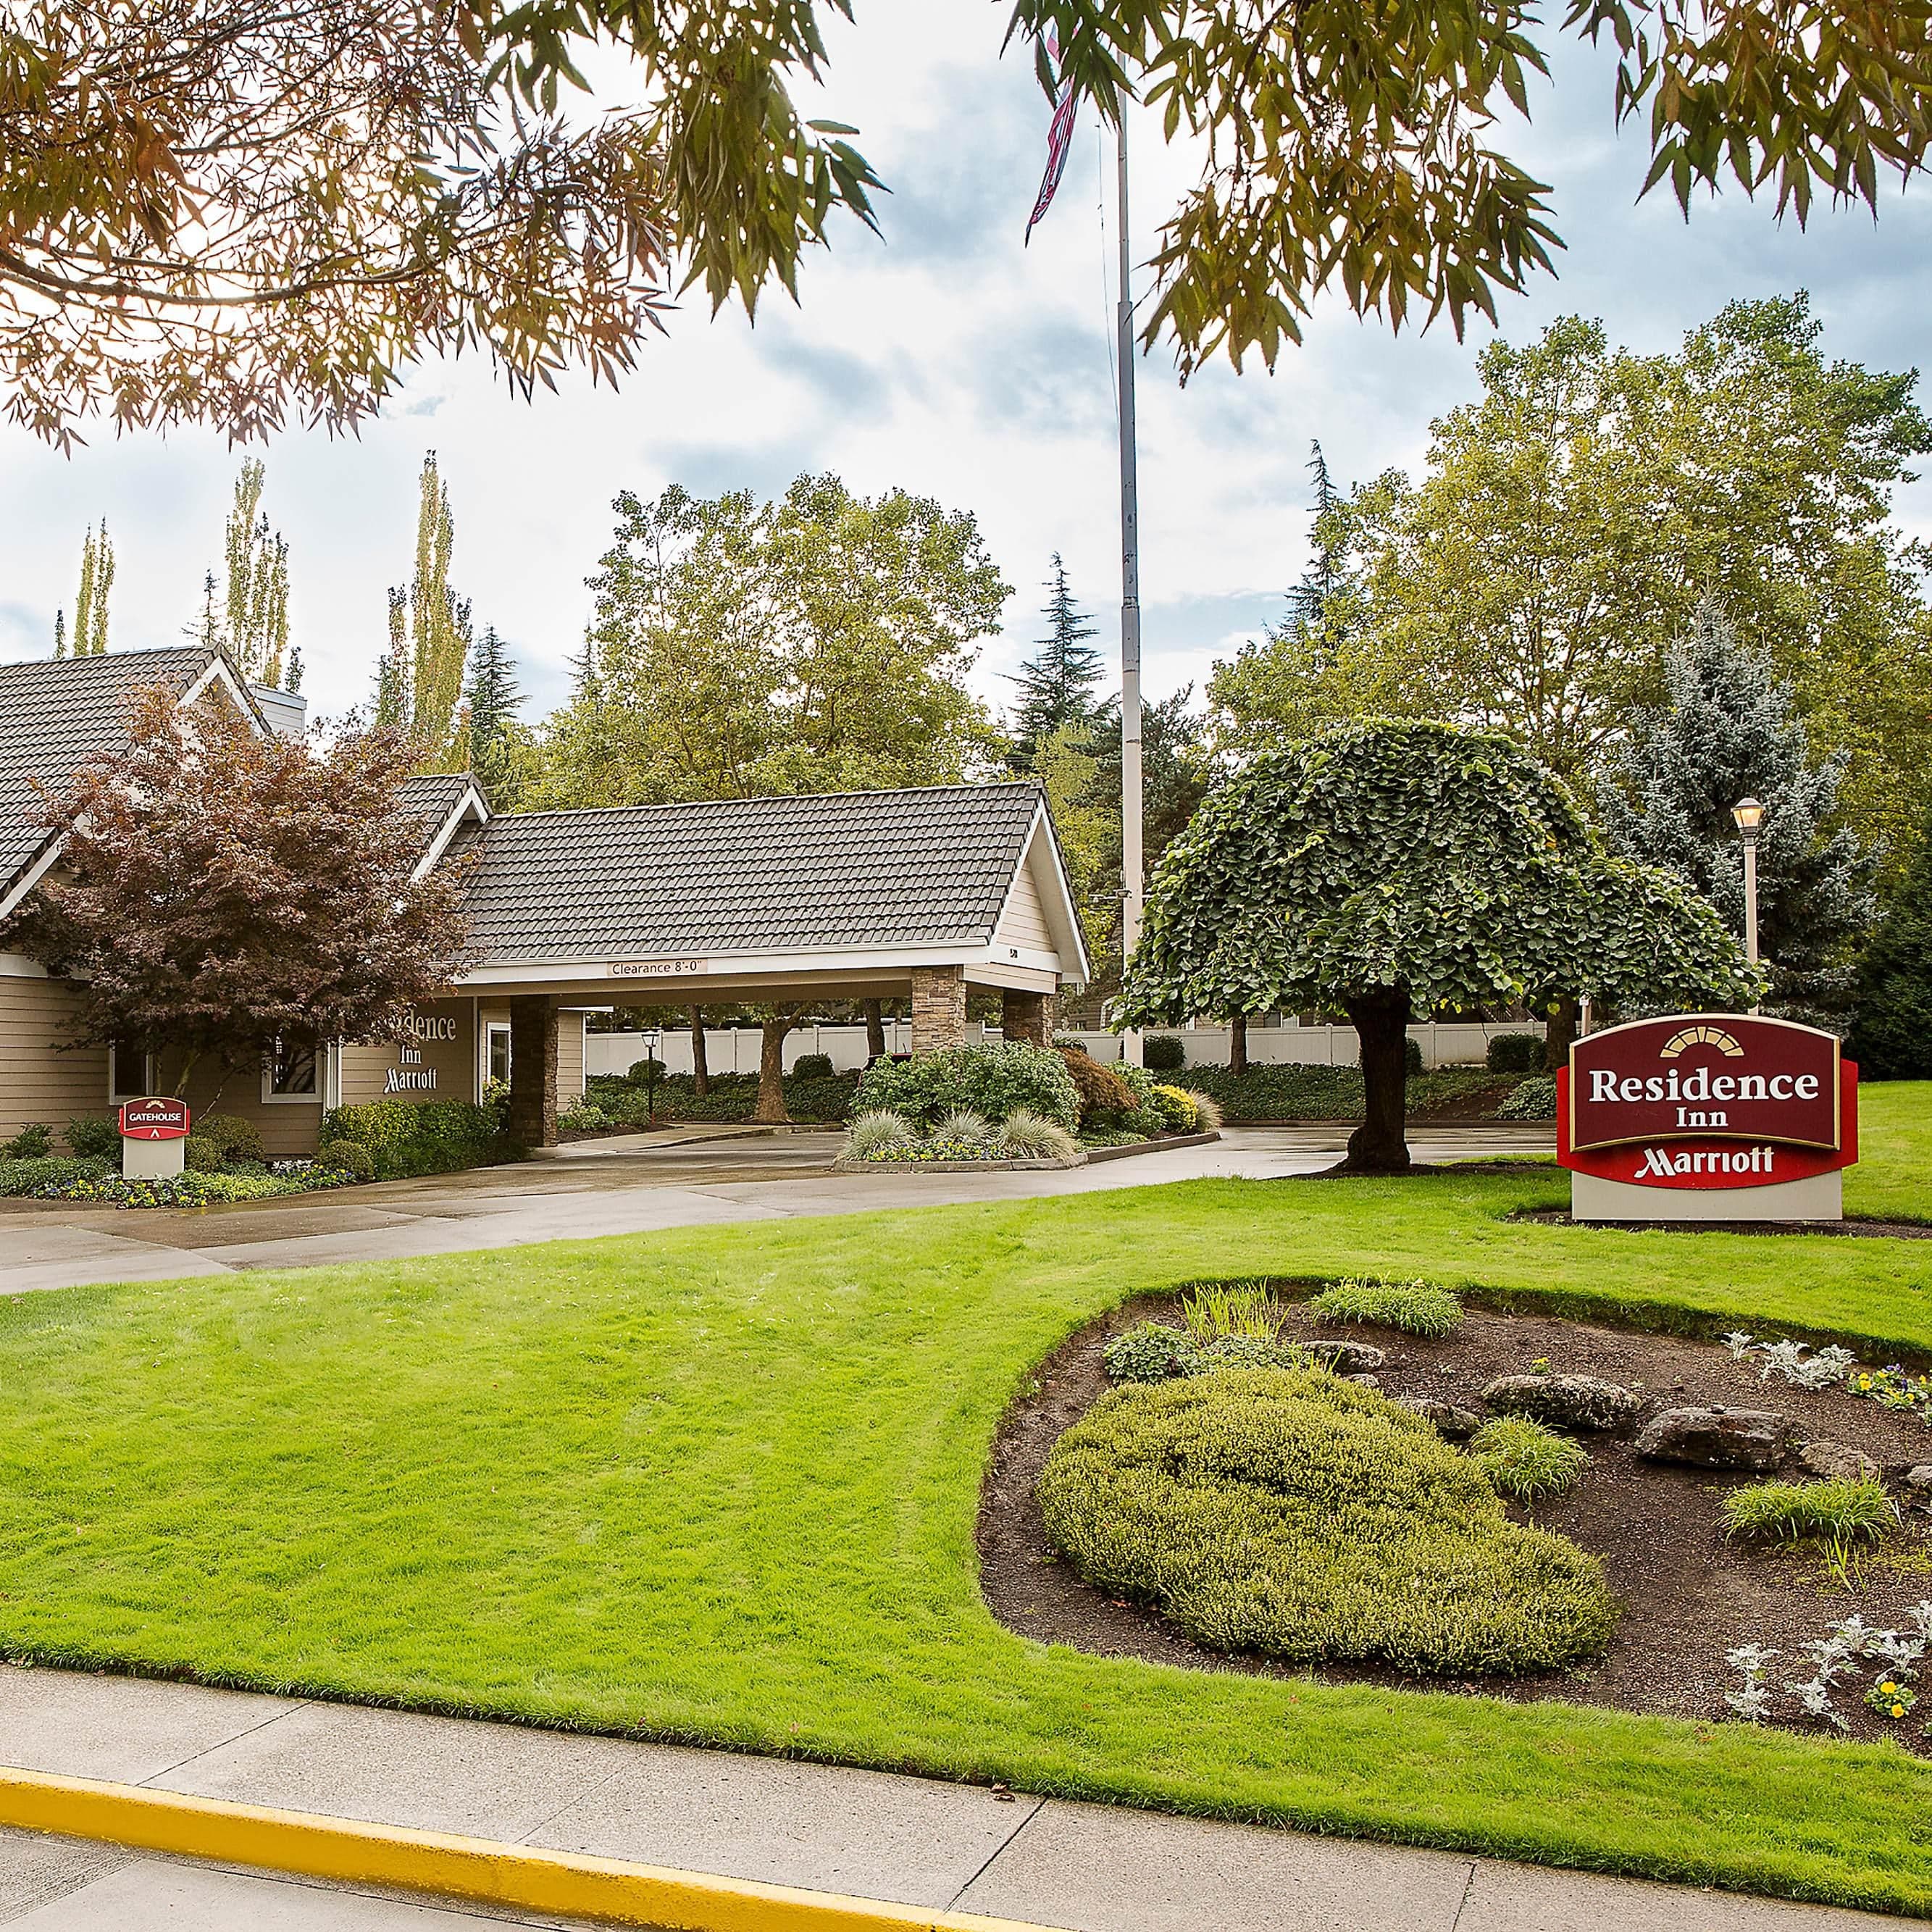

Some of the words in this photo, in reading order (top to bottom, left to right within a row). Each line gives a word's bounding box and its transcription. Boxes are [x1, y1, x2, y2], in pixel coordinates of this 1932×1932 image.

[612, 963, 671, 974] Clearance
[400, 1045, 422, 1064] Inn
[383, 1068, 438, 1094] Marriott
[1589, 1066, 1819, 1102] Residence
[129, 1113, 182, 1121] GATEHOUSE
[1676, 1107, 1728, 1127] Inn
[1634, 1146, 1774, 1179] Marriott
